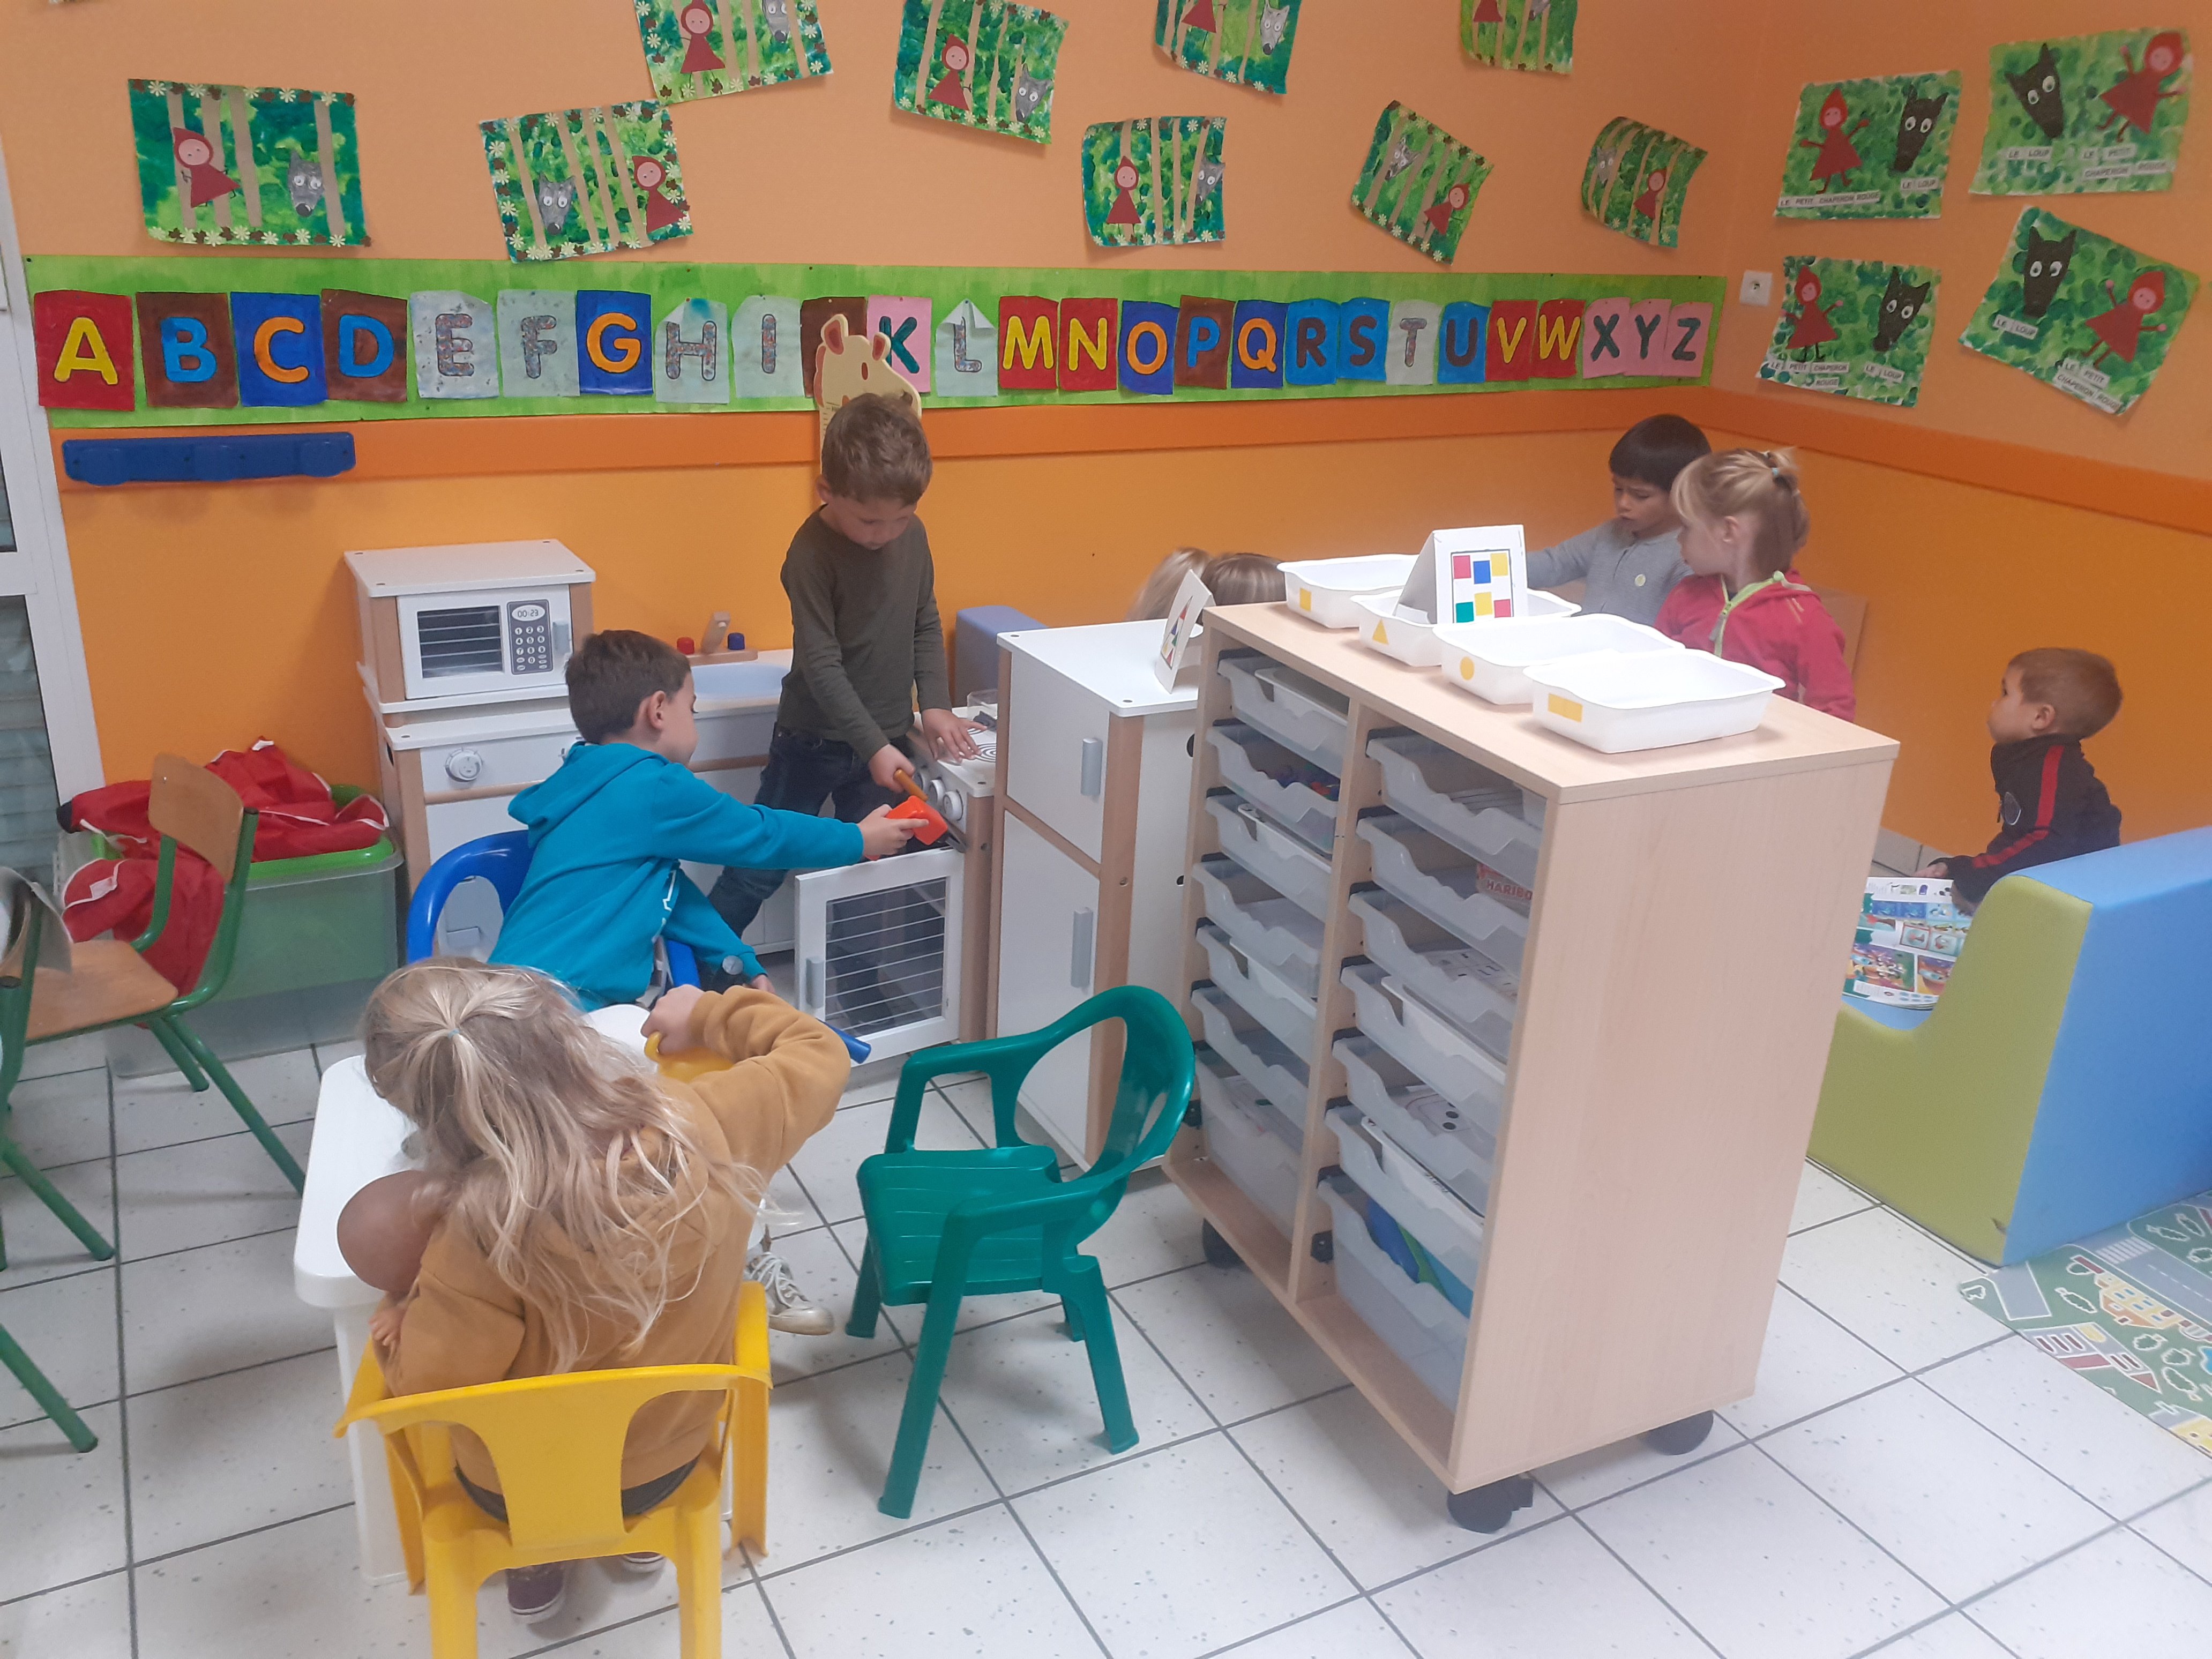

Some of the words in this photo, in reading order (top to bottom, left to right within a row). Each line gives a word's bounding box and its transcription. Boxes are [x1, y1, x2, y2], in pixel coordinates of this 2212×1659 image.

[2028, 149, 2050, 157] LOUP
[1917, 179, 1936, 188] LOUP
[2016, 325, 2035, 335] LOUP
[54, 316, 119, 385] A
[160, 316, 218, 383] B
[253, 316, 310, 384] C
[338, 313, 395, 378] D
[435, 313, 475, 377] E
[521, 314, 557, 379] F
[586, 311, 642, 374] G
[665, 320, 718, 382] H
[761, 313, 776, 374] I
[879, 316, 921, 375] K
[953, 316, 982, 373] L
[1002, 315, 1054, 370] M
[1067, 317, 1108, 371] N
[1126, 321, 1168, 375] O
[1186, 316, 1220, 368] P
[1237, 317, 1277, 373] Q
[1296, 317, 1327, 368] R
[1349, 315, 1378, 367] S
[1399, 317, 1428, 368] T
[1445, 318, 1478, 367] U
[1497, 316, 1527, 364] V
[1538, 314, 1581, 361] W
[1590, 313, 1620, 362] X
[1634, 314, 1662, 360] Y
[1671, 317, 1702, 362] Z
[1789, 363, 1807, 371] PETIT
[1883, 370, 1902, 379] LOUP
[2084, 370, 2105, 384] PETIT
[2057, 374, 2094, 398] CHAPERON
[1486, 879, 1533, 901] HARIBO
